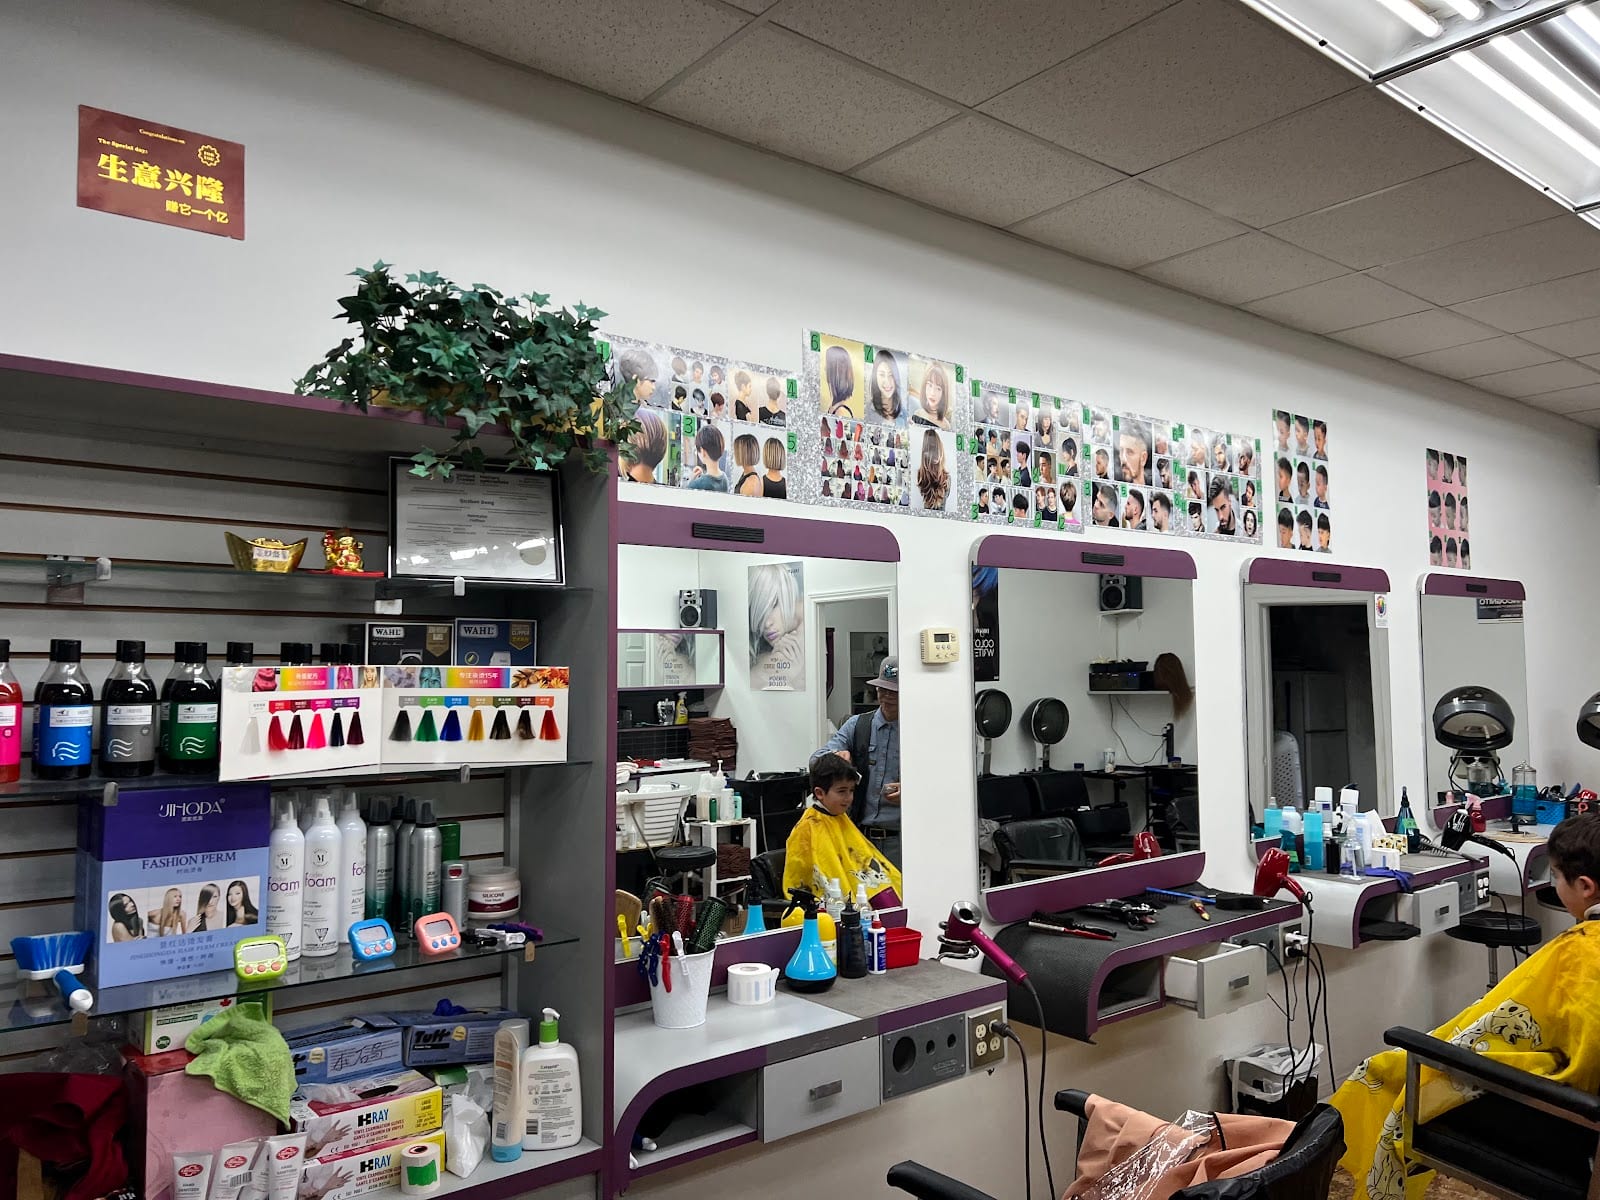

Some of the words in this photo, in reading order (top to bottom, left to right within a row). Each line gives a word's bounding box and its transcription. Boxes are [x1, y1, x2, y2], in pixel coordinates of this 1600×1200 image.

[97, 137, 111, 145] The
[98, 153, 224, 204] 生意兴隆
[811, 334, 819, 350] 6
[865, 346, 873, 362] 7
[956, 366, 963, 382] 8
[788, 381, 796, 397] 4
[1032, 393, 1040, 407] 7
[684, 417, 693, 434] 3
[787, 434, 795, 450] 5
[970, 441, 978, 455] 2
[1083, 445, 1090, 458] 2
[1013, 470, 1021, 485] 5
[971, 504, 978, 520] 3
[1008, 510, 1014, 523] 6
[375, 628, 401, 636] WAHL
[464, 626, 494, 635] WAHL
[141, 855, 199, 870] FASHION
[202, 851, 237, 863] PERM
[352, 862, 367, 877] foa
[267, 876, 300, 892] foam
[305, 872, 336, 888] foam
